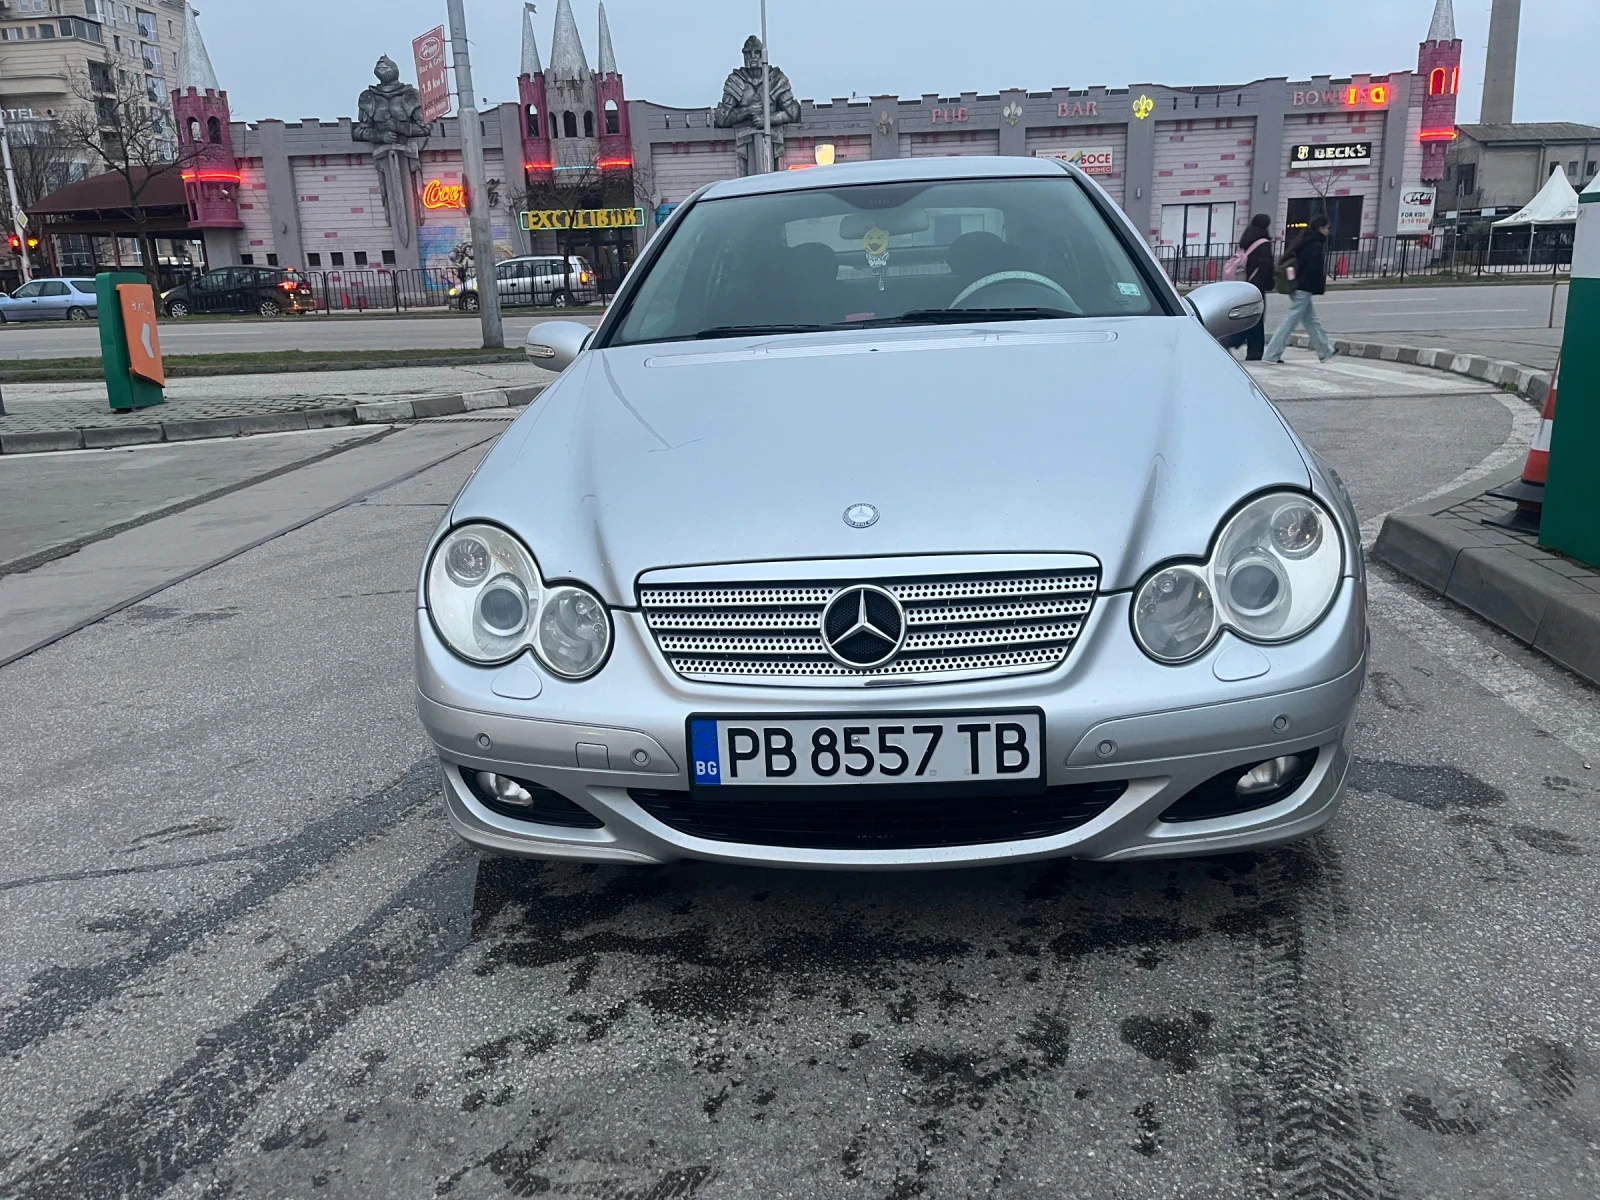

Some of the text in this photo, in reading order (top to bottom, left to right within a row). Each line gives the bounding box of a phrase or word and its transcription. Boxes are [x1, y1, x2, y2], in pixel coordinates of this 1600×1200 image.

[419, 64, 428, 74] Bar
[422, 80, 432, 94] 1.8
[931, 107, 969, 124] PUB
[1057, 101, 1098, 118] BAR
[1314, 144, 1367, 159] BECK'S
[727, 722, 1030, 777] PB 8557 TB
[696, 761, 718, 776] BG
